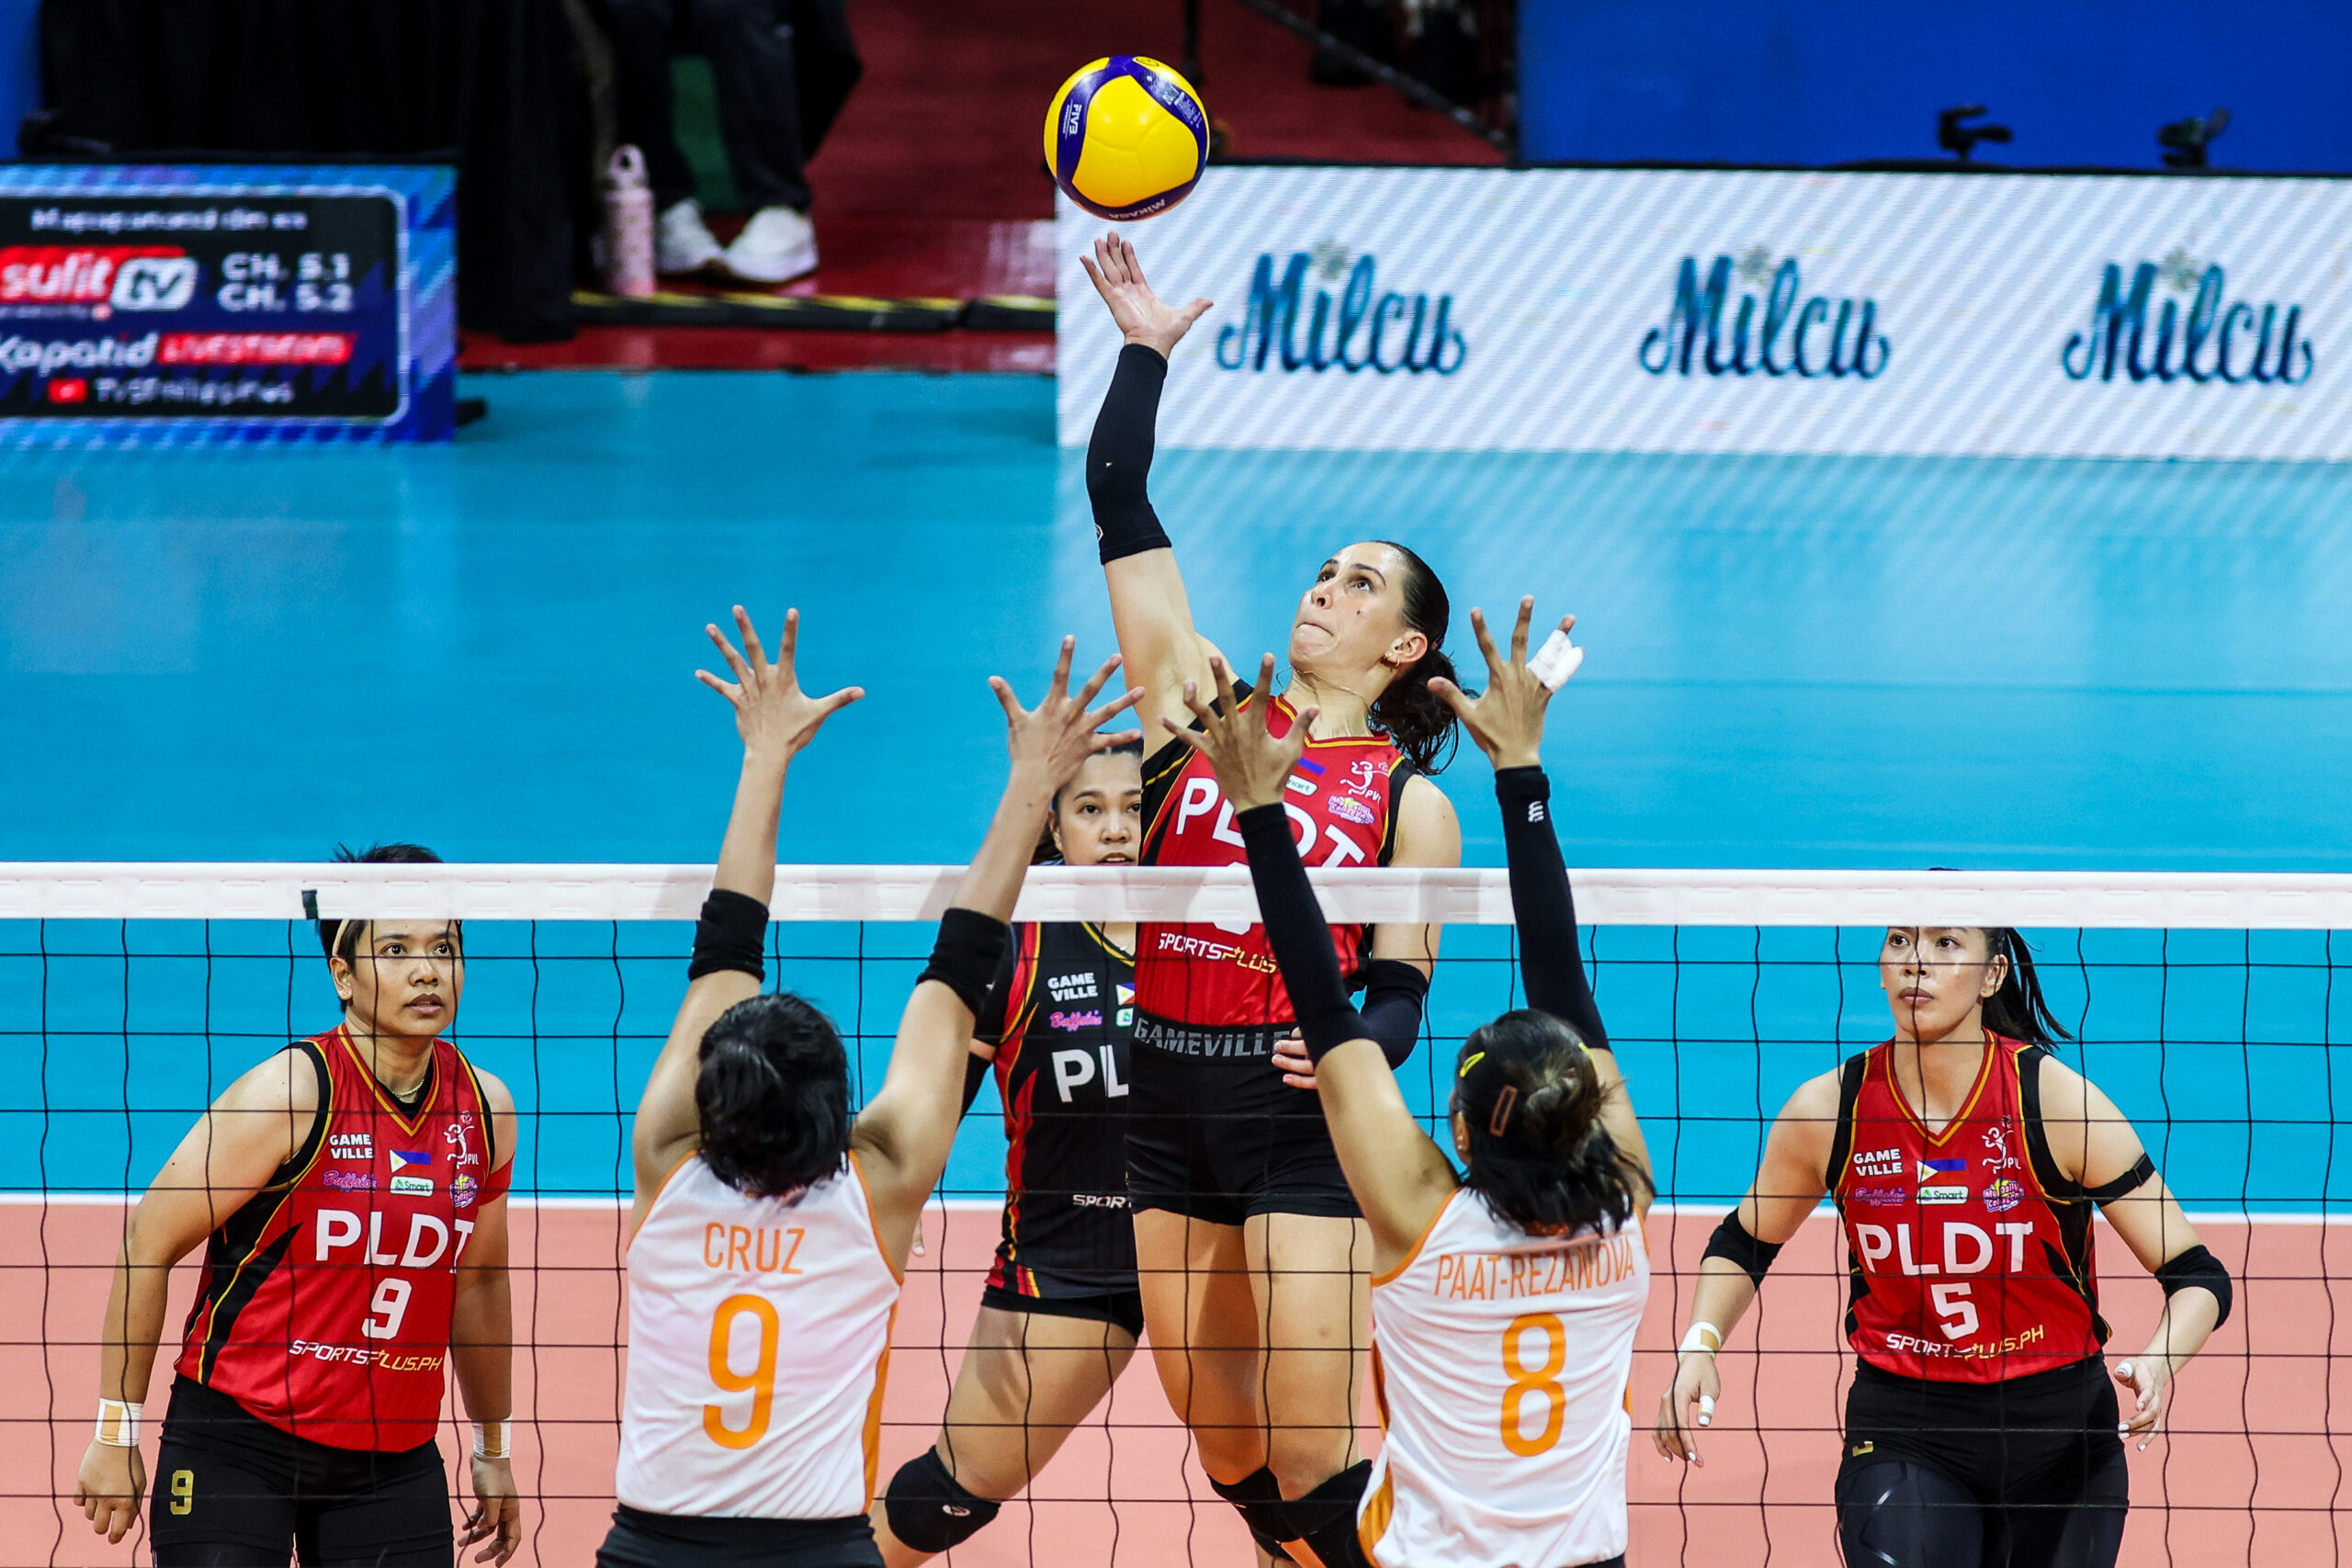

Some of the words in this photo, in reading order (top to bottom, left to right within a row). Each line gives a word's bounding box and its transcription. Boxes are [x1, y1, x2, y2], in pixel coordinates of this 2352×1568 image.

[2, 251, 112, 298] sulit
[1216, 252, 1467, 376] Milcu
[1638, 255, 1890, 379] Milcu
[2064, 261, 2313, 385] Milcu
[1159, 932, 1277, 974] SPORTSPLUS
[1047, 972, 1095, 989] GAME
[1051, 985, 1099, 1002] VILLE
[1052, 1044, 1129, 1102] PL
[329, 1134, 372, 1146] GAME
[330, 1147, 374, 1159] VILLE
[1853, 1148, 1901, 1164] GAME
[404, 1180, 430, 1192] Smart
[1855, 1162, 1903, 1177] VILLE
[1073, 1194, 1131, 1209] SPOR
[1934, 1190, 1964, 1200] Smart
[704, 1222, 805, 1275] CRUZ
[1434, 1235, 1635, 1301] PAAT-REZANOVA
[1855, 1221, 2033, 1276] PLDT
[361, 1278, 413, 1339] 9
[1930, 1282, 1979, 1340] 5
[702, 1293, 779, 1450] 9
[1500, 1312, 1566, 1457] 8
[170, 1470, 194, 1515] 9
